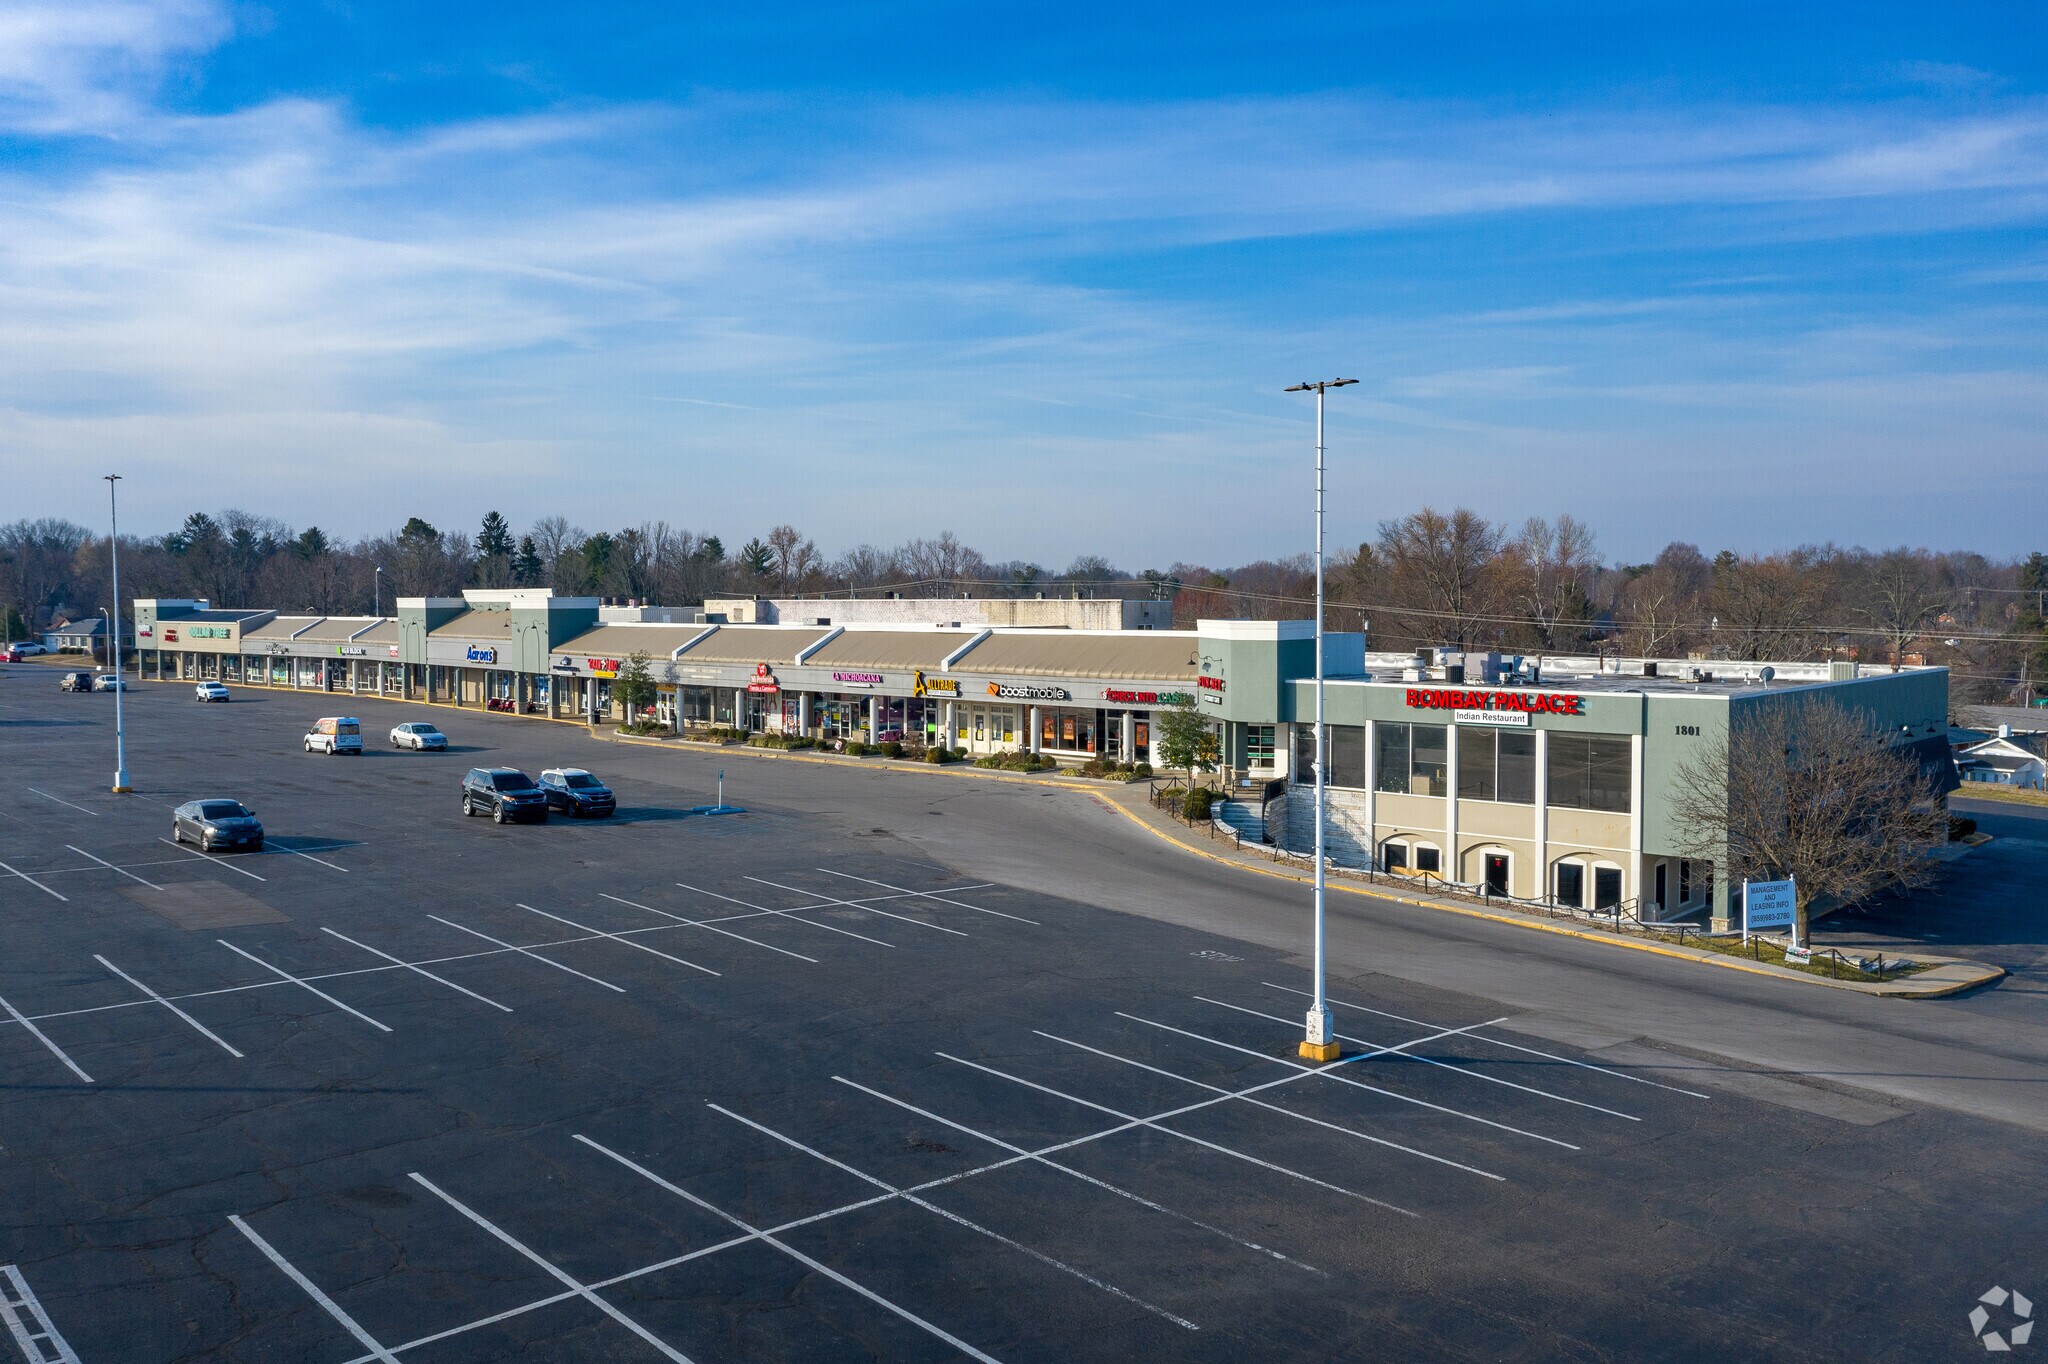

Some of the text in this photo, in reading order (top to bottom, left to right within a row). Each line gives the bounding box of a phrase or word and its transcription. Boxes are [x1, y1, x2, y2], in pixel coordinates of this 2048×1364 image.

[213, 627, 228, 639] TREE
[467, 645, 493, 662] Aaron's
[841, 672, 880, 683] MICHOACANA
[927, 679, 957, 691] ALLTRADE
[1108, 690, 1136, 702] CHECK
[1138, 691, 1157, 703] INTO
[1406, 689, 1579, 714] BOMBAY PALACE
[1456, 711, 1526, 723] Indian Restaurant
[1675, 725, 1700, 736] 1801
[1750, 884, 1789, 894] MANAGEMENT
[1763, 893, 1776, 901] AND
[1751, 901, 1790, 911] LEASING INFO
